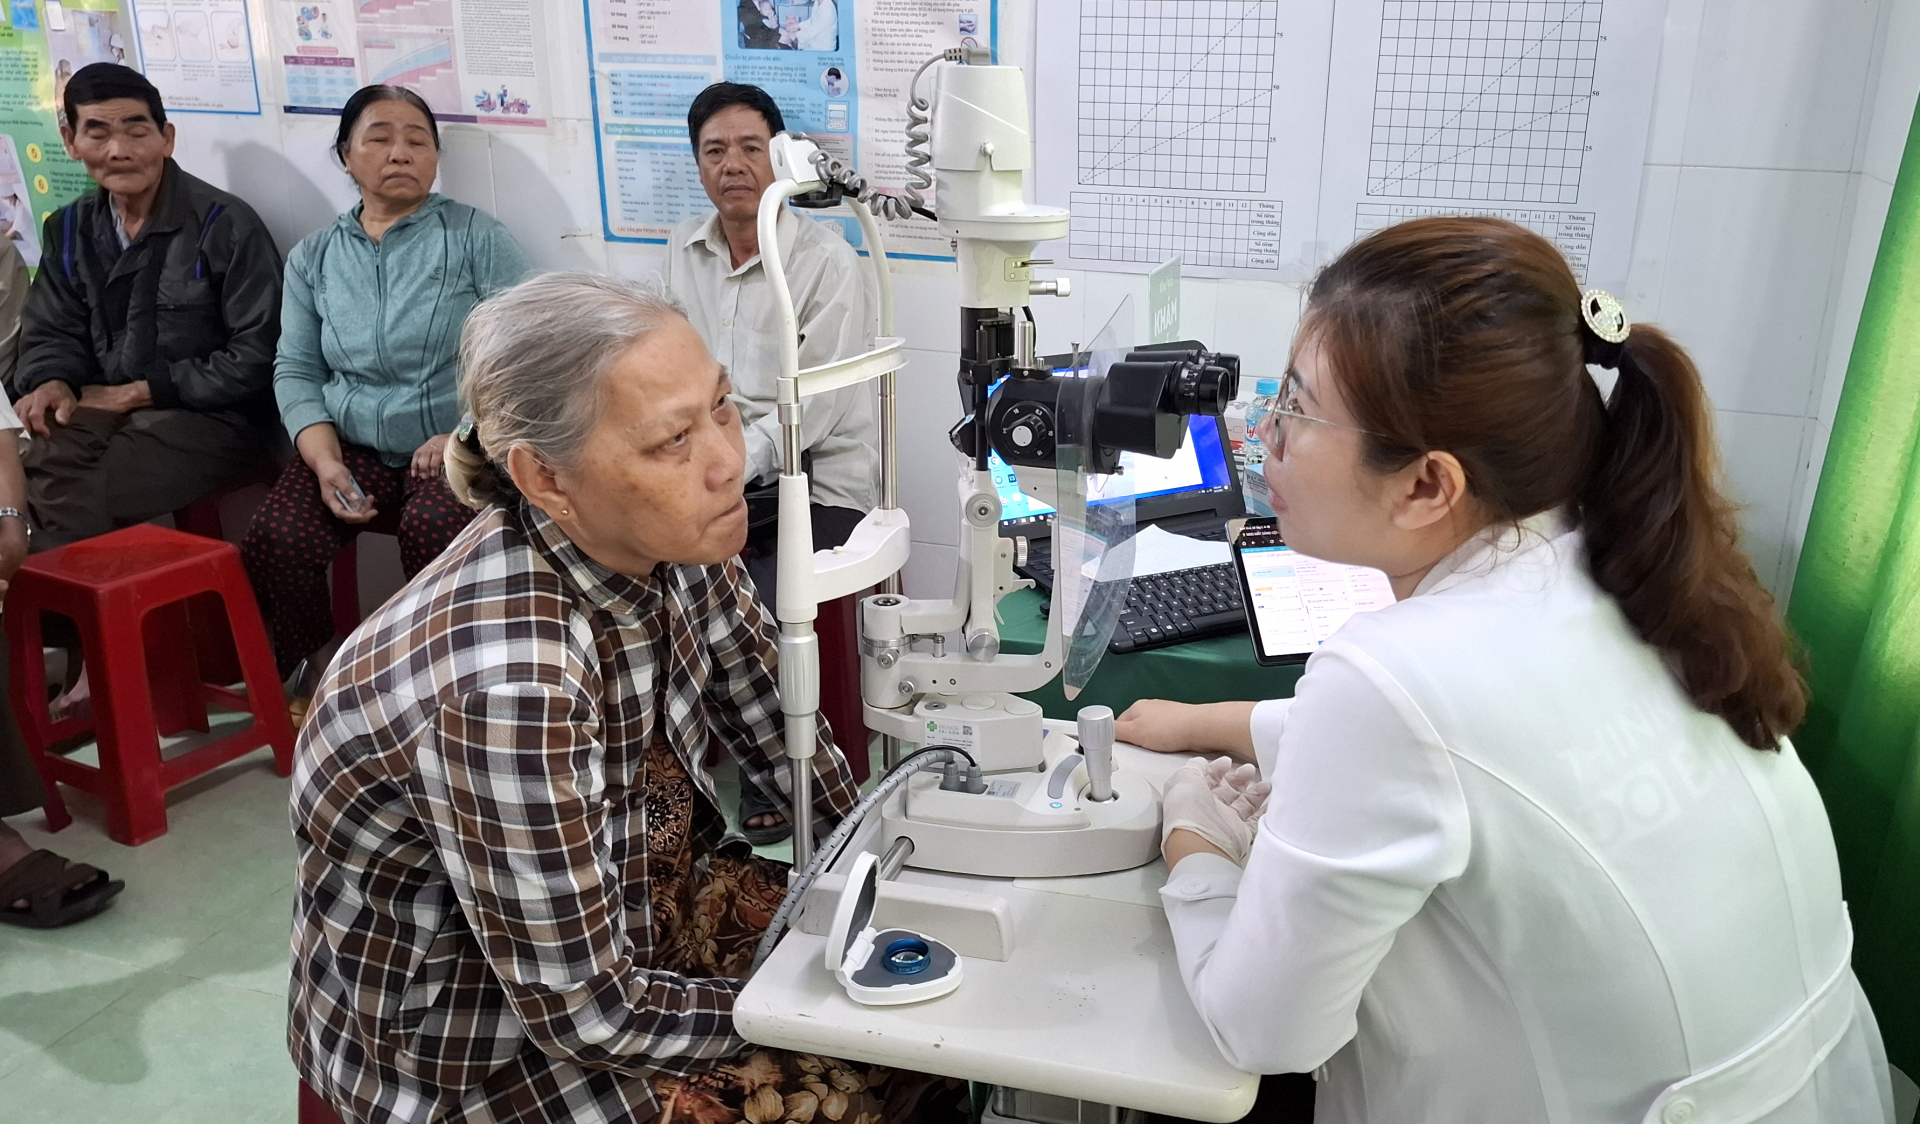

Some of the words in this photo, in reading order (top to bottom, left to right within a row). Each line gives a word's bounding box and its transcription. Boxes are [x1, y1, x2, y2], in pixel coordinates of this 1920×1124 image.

[32, 148, 37, 158] 5
[39, 180, 44, 189] 6
[1154, 295, 1177, 338] KHÁM
